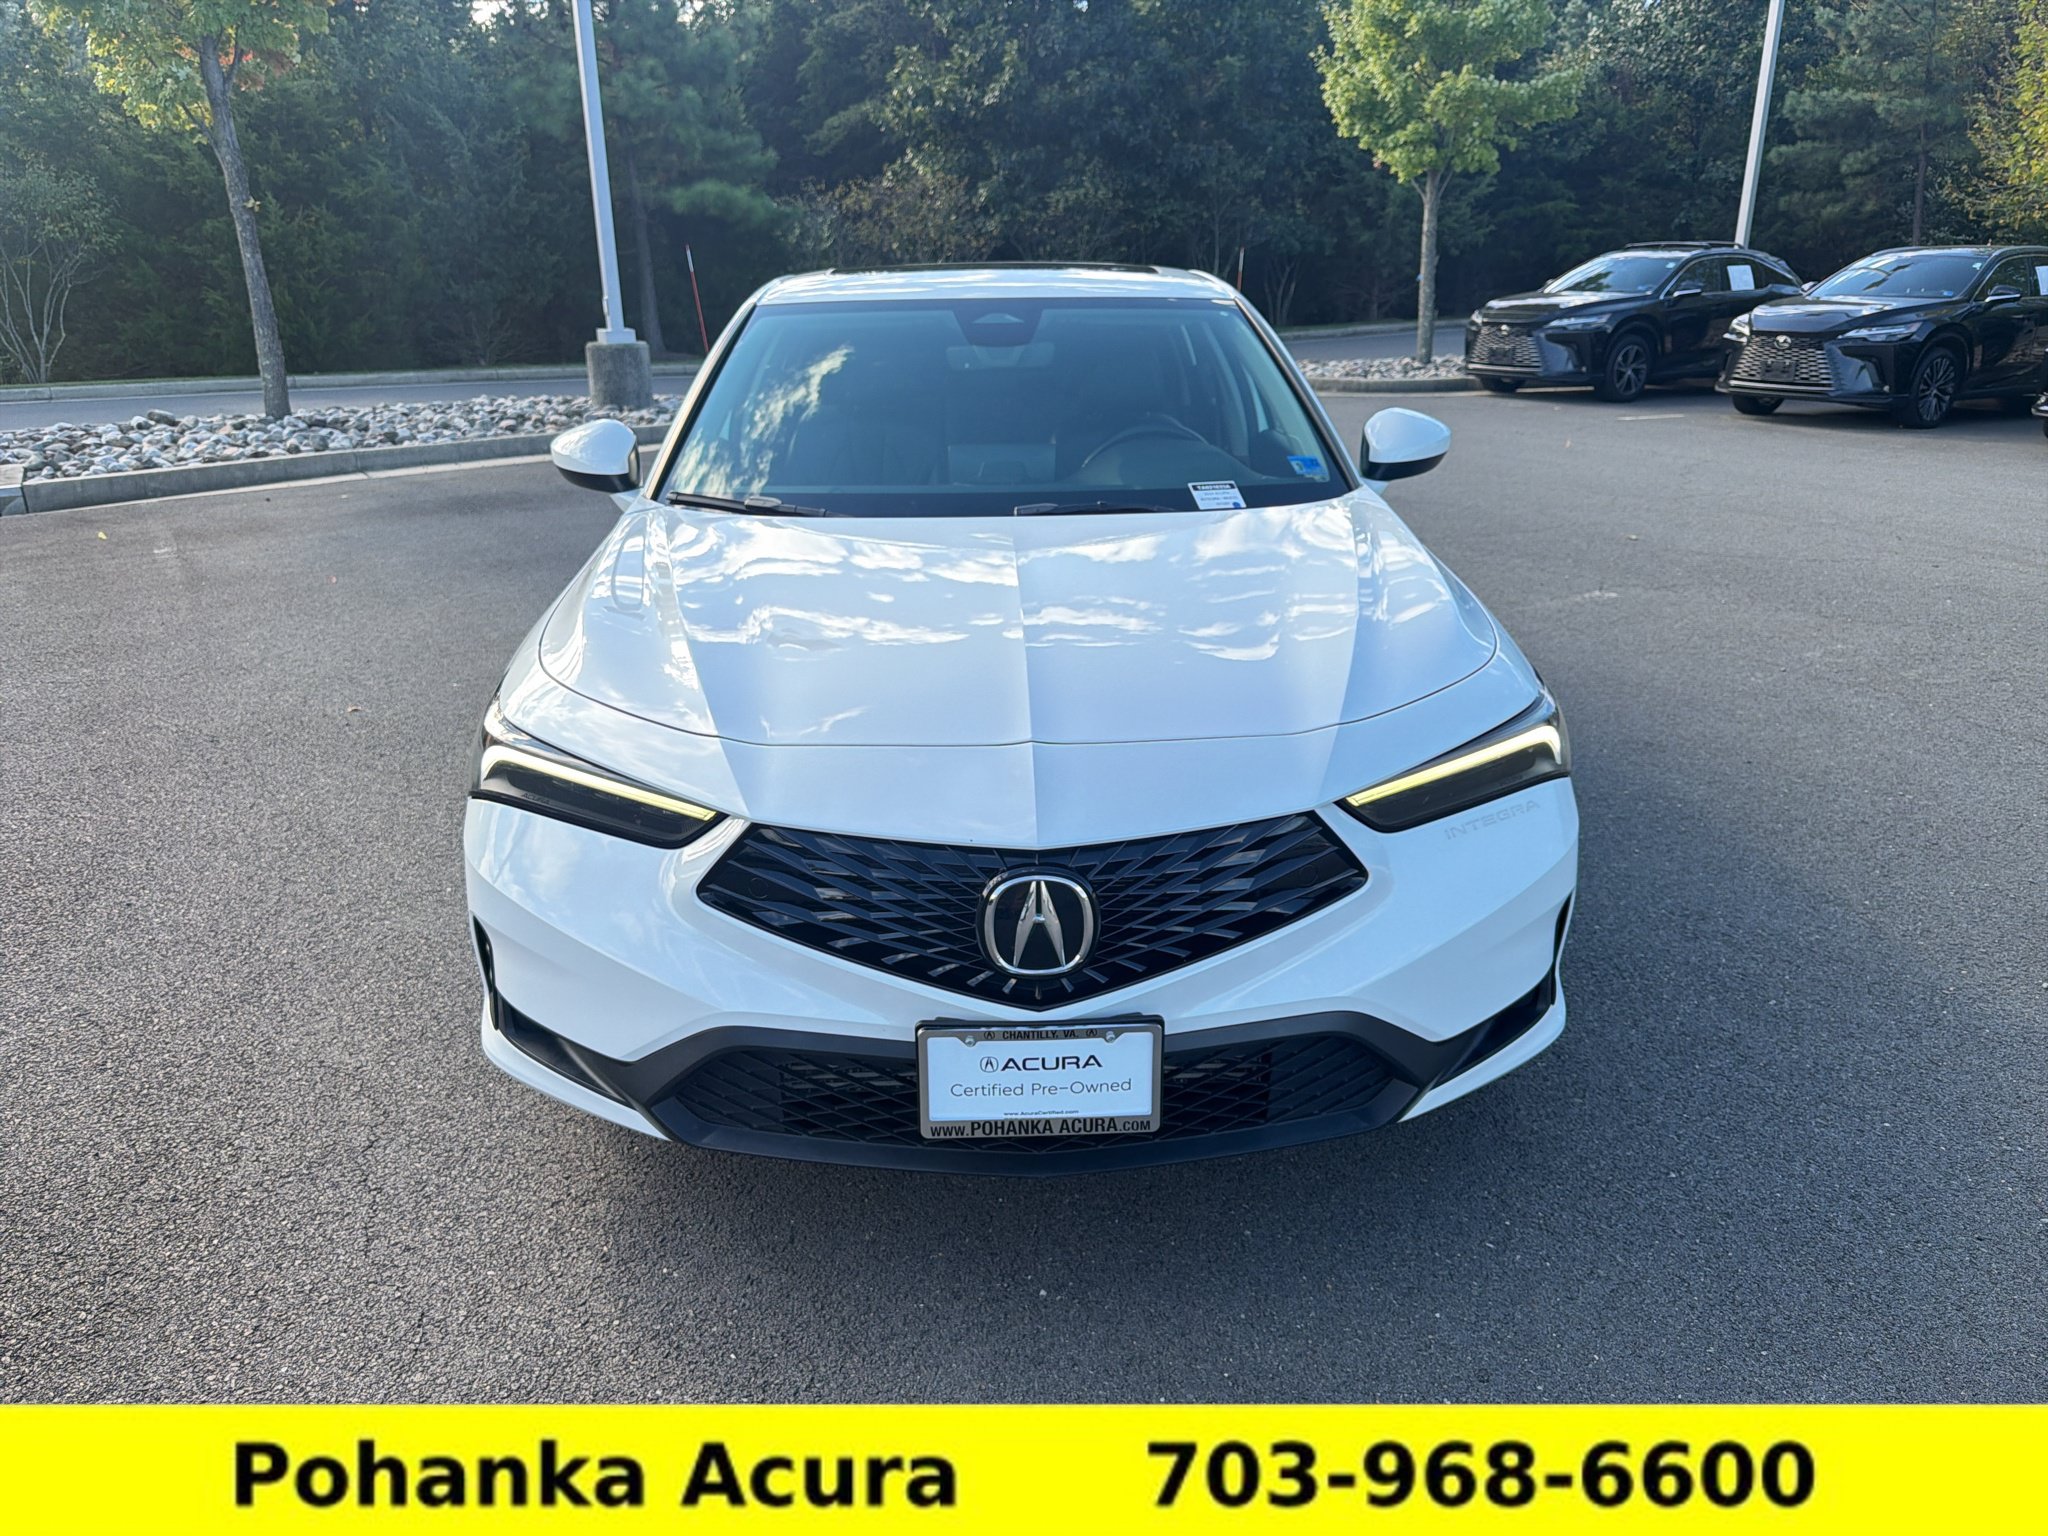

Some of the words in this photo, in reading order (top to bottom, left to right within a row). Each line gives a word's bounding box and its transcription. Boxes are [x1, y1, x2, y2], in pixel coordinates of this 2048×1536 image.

[1444, 799, 1541, 840] INTEGRA
[1000, 1054, 1103, 1072] ACURA
[950, 1083, 1024, 1097] Certified
[1031, 1078, 1132, 1096] Pre-Owned
[1058, 1117, 1151, 1134] ACURA.COM
